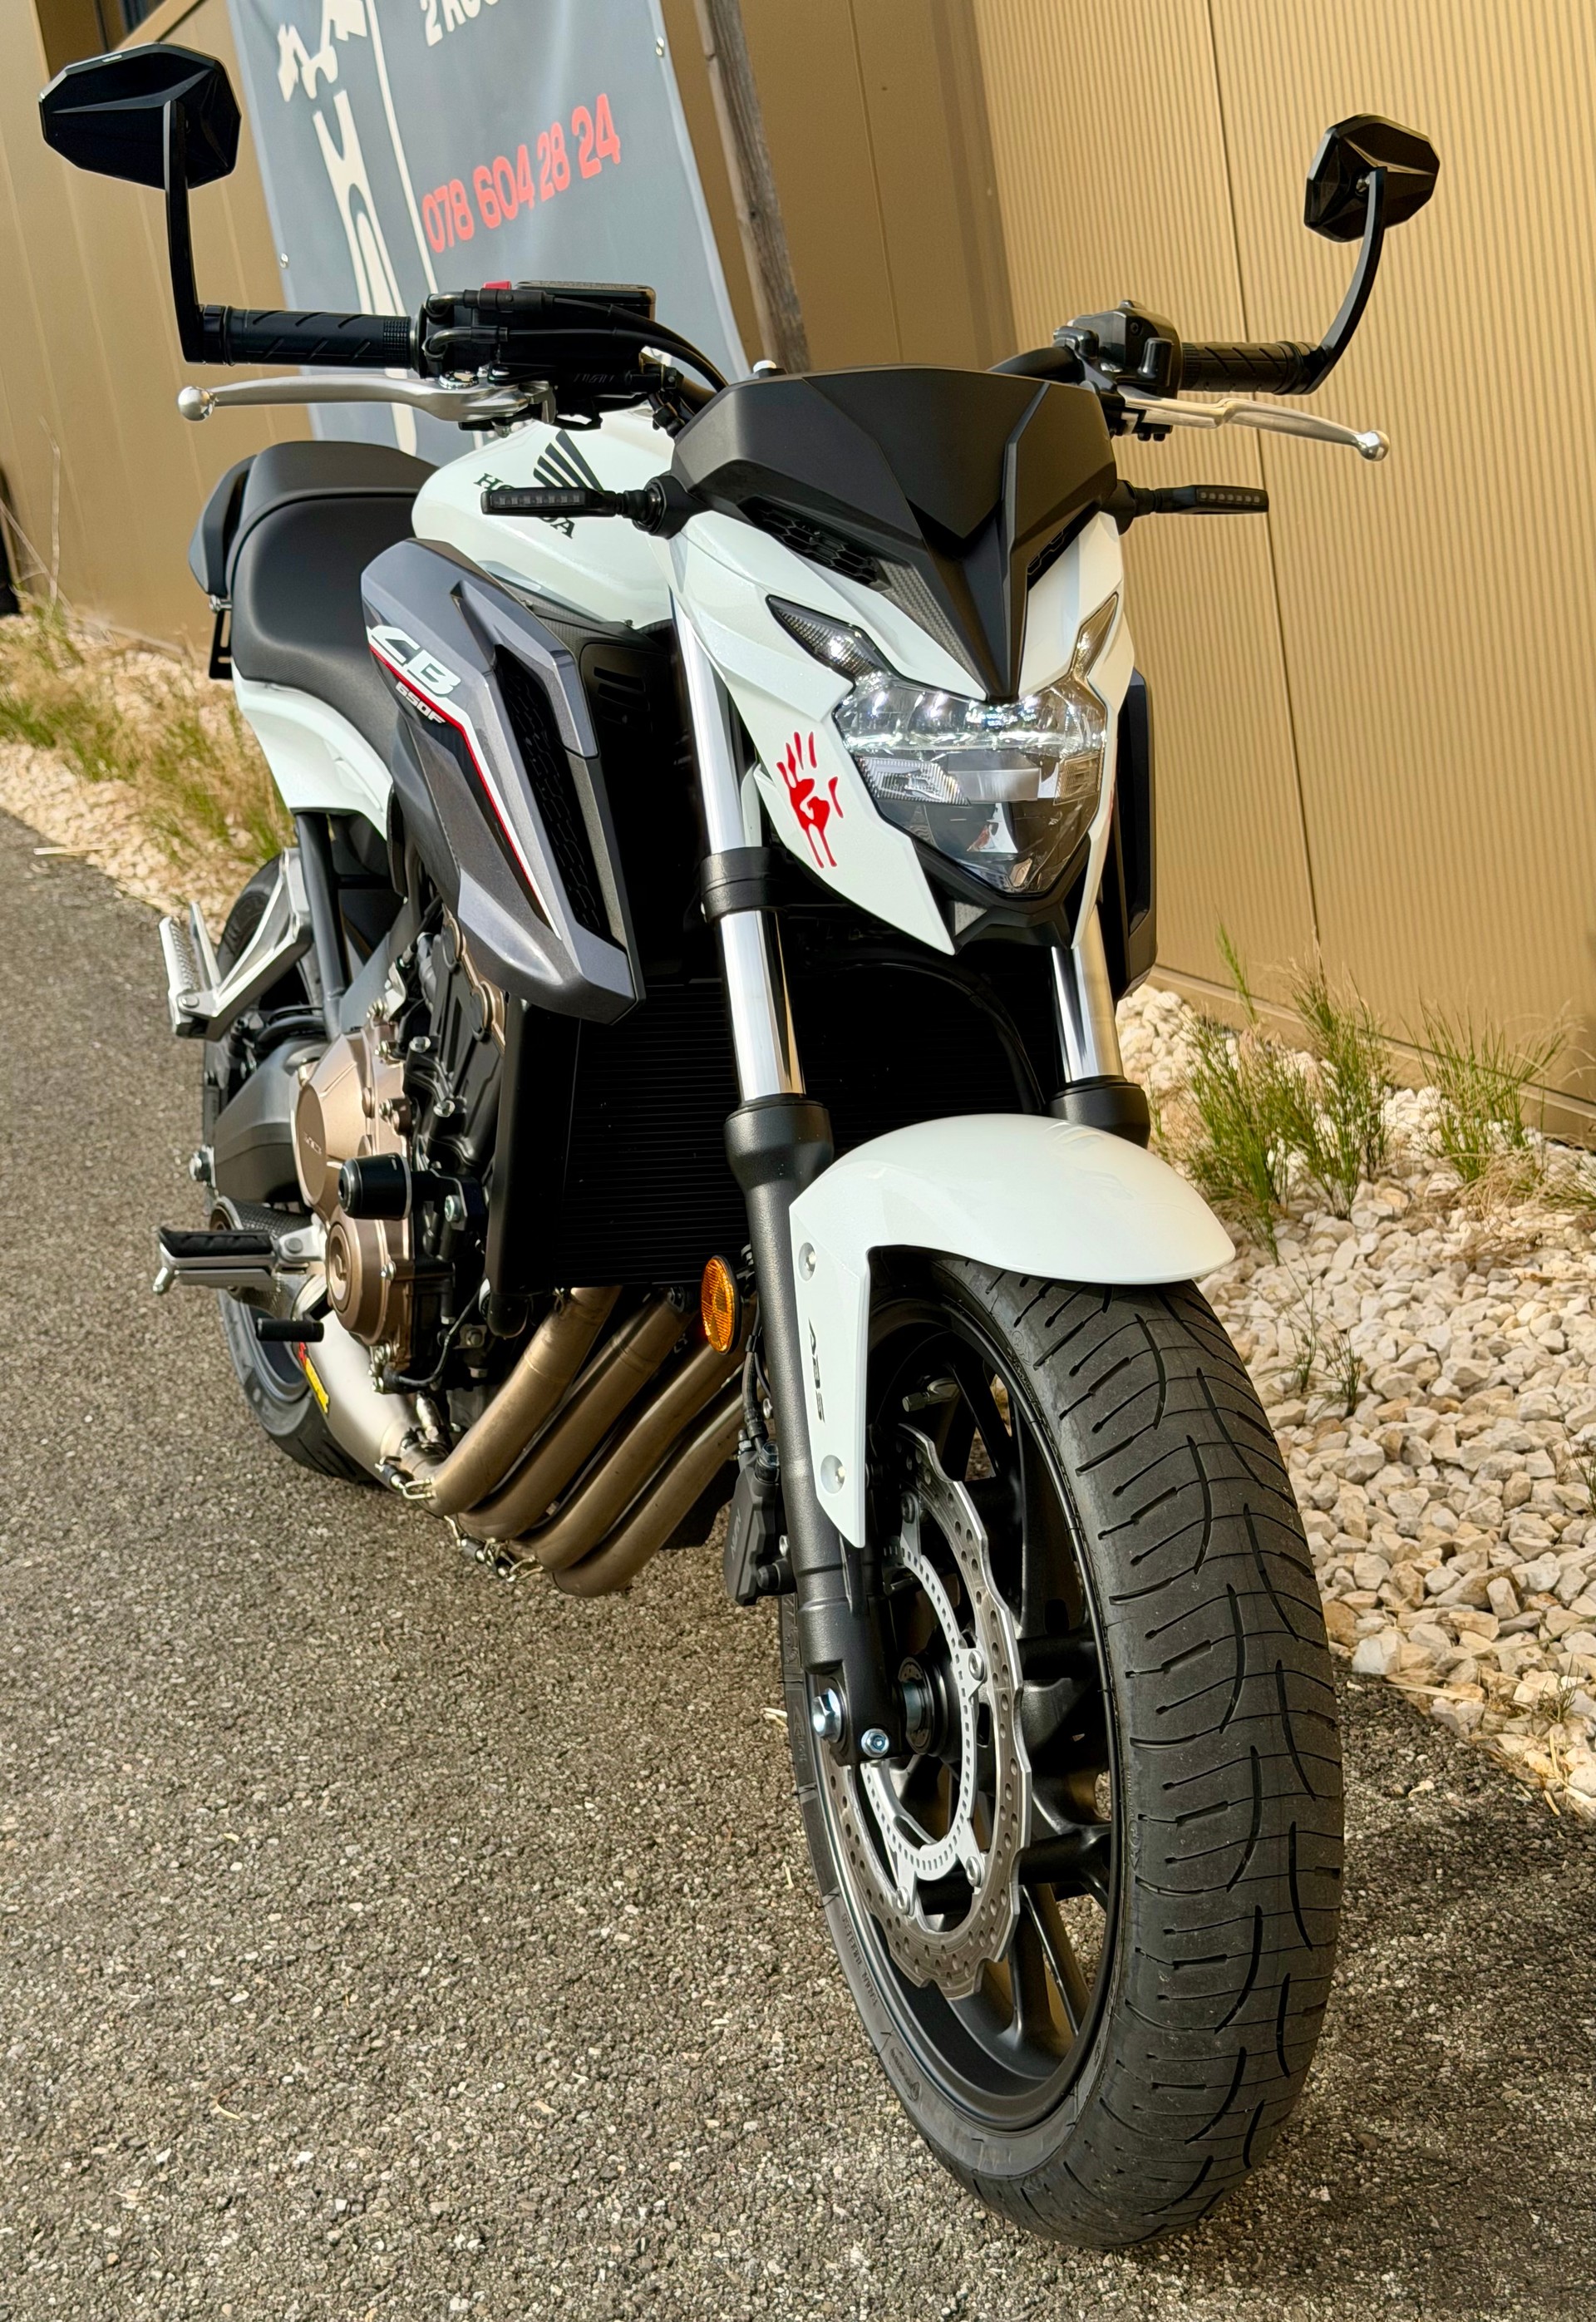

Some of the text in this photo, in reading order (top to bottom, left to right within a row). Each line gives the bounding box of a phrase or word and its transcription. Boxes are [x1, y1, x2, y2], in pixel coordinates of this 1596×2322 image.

[422, 92, 620, 253] 078 604 28 24
[371, 625, 461, 695] CB
[395, 681, 446, 724] 650F
